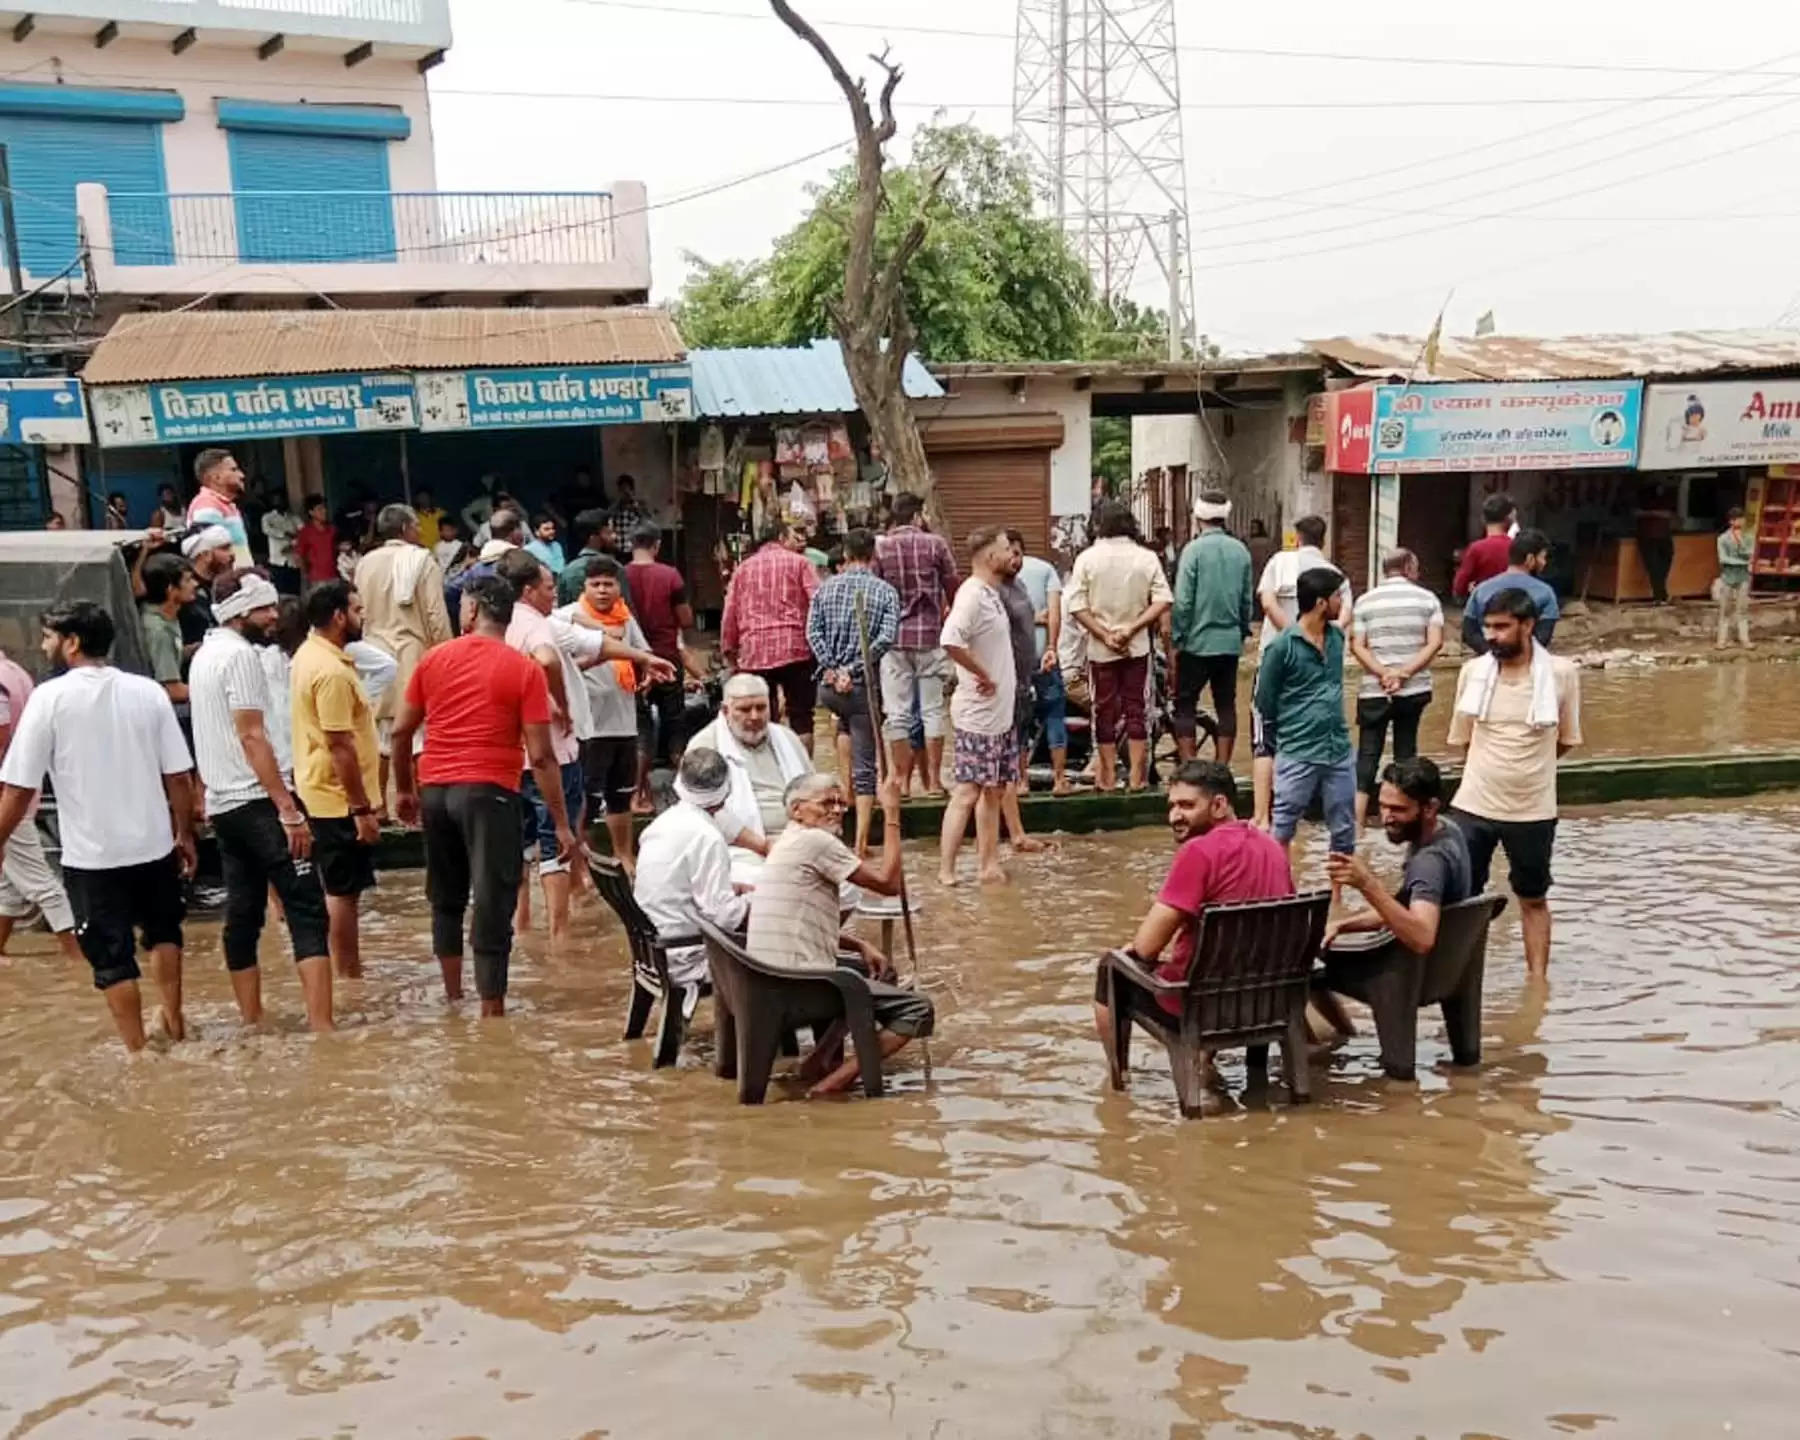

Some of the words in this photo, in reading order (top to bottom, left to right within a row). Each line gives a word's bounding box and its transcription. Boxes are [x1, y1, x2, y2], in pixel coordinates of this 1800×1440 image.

[161, 388, 232, 419] विजय
[293, 384, 364, 410] भण्डार
[475, 378, 535, 404] विजय
[589, 376, 650, 400] भण्डार
